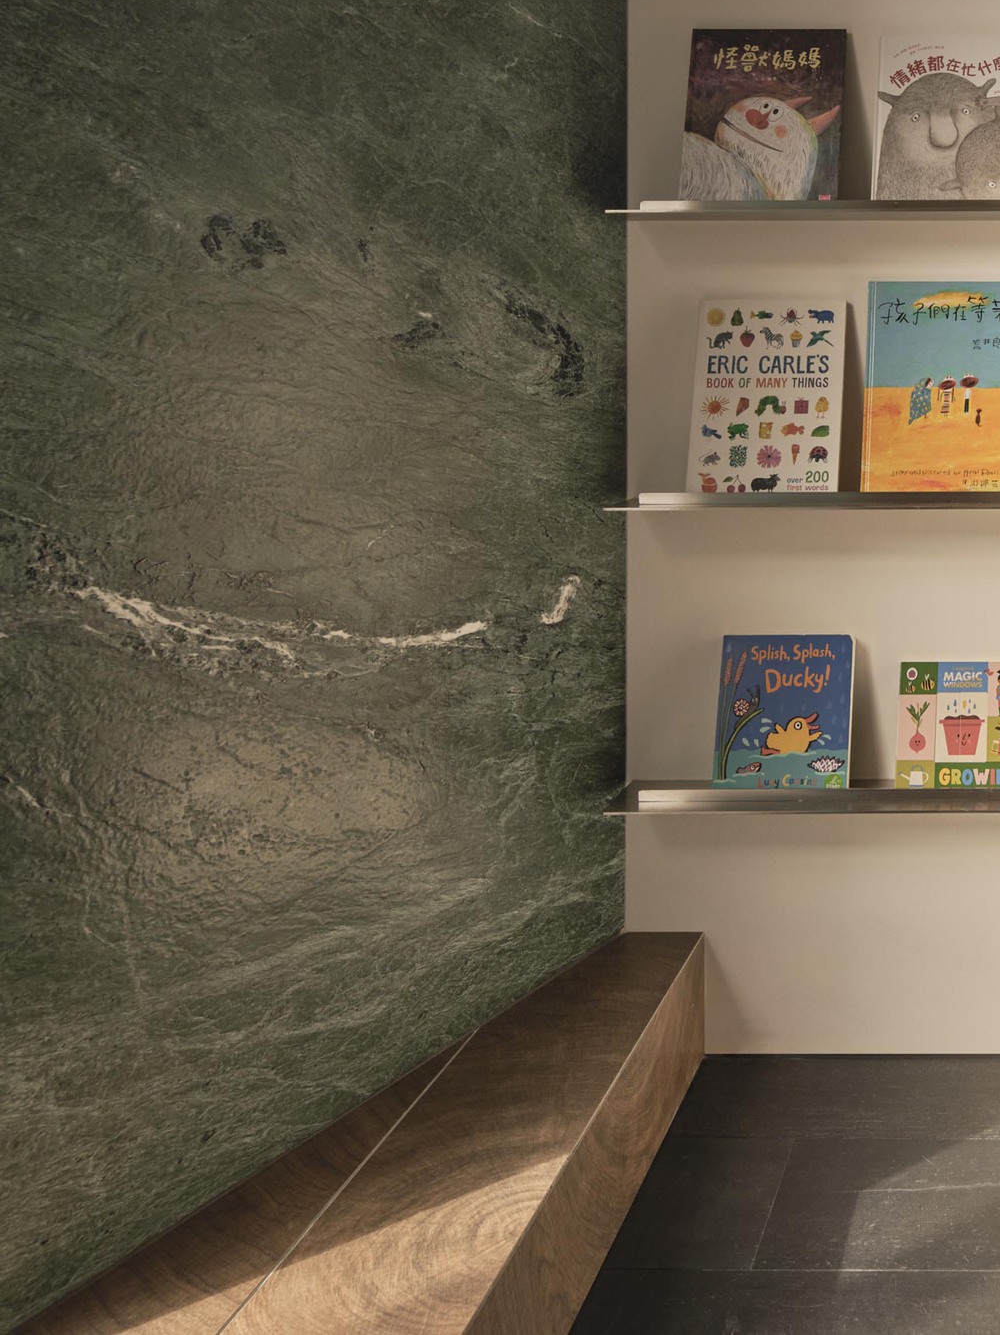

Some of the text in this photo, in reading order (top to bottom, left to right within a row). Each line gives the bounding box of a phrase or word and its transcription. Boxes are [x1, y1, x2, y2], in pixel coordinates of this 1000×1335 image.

[713, 44, 821, 72] 怪獸媽媽
[706, 354, 830, 375] ERIC CARLE'S
[706, 377, 829, 389] BOOK OF MANY THINGS
[805, 470, 830, 483] 200
[750, 643, 836, 665] Splish, Splash,
[765, 664, 831, 694] Ducky!
[943, 671, 983, 682] MAGIC
